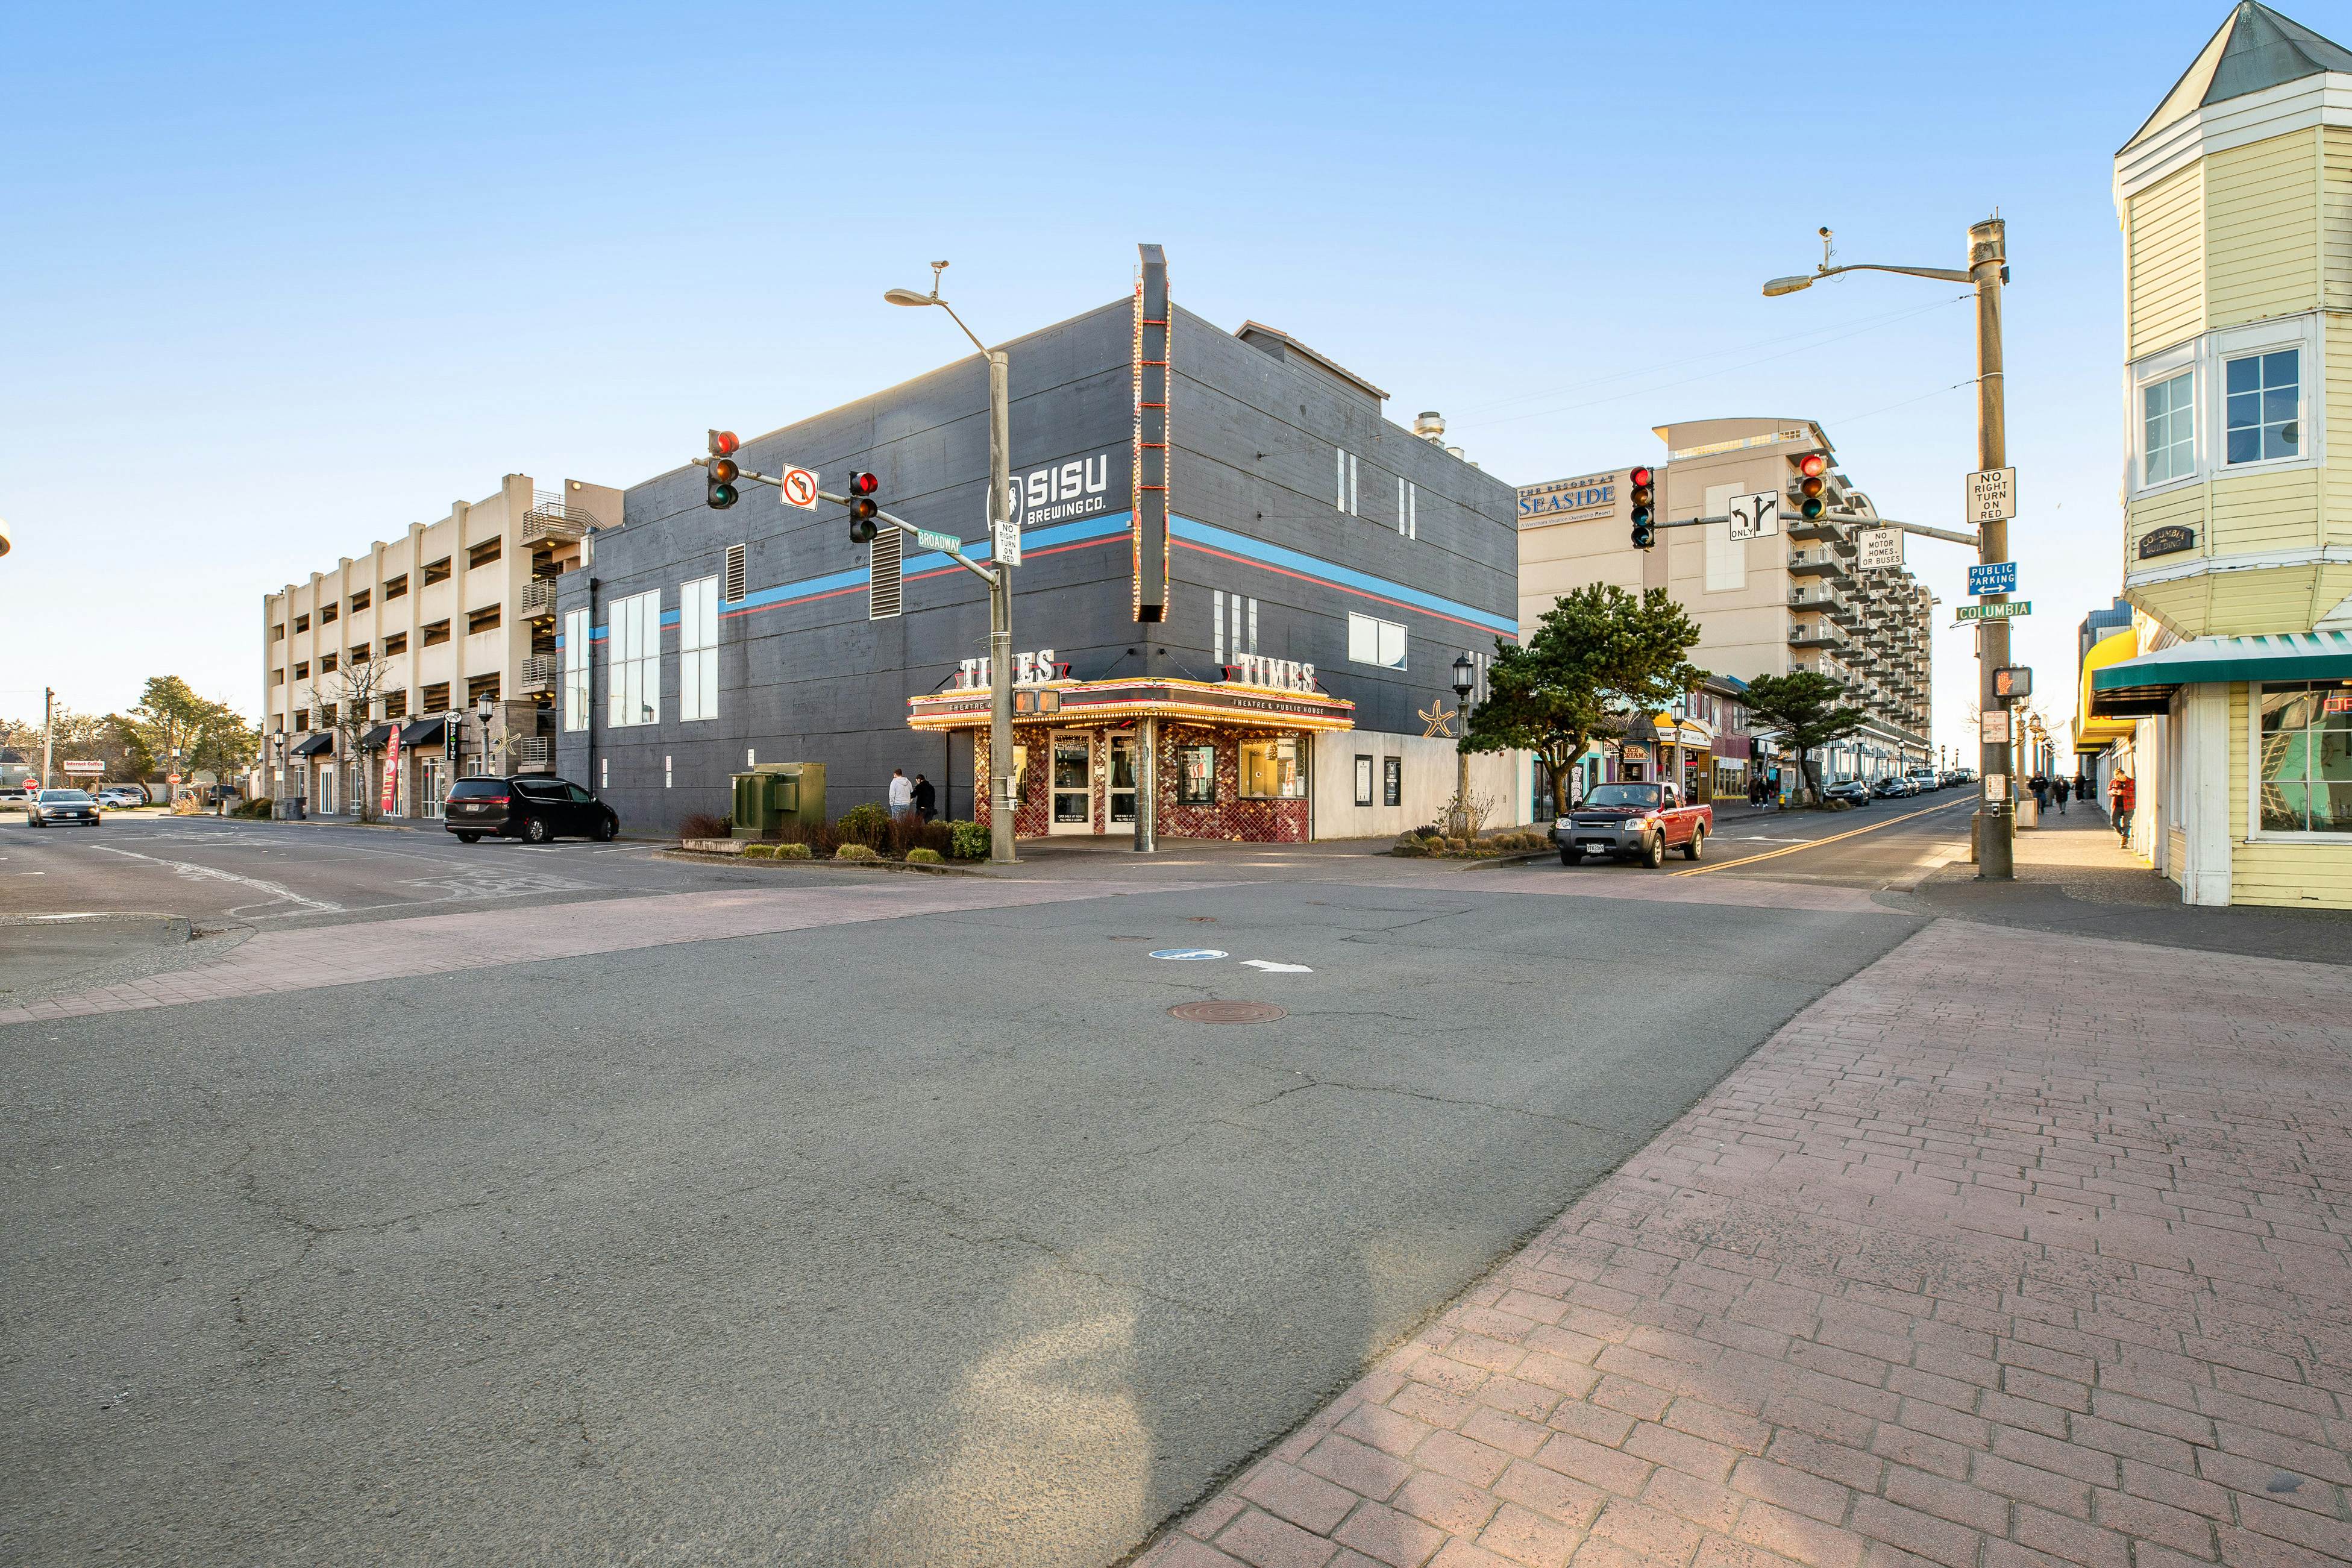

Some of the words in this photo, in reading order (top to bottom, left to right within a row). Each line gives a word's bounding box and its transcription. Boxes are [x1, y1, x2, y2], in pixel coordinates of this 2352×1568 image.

[1027, 454, 1107, 507] SISU
[1981, 472, 2001, 483] NO
[1519, 488, 1541, 497] THE
[1548, 478, 1594, 492] RESORT
[1600, 475, 1614, 483] AT
[1975, 481, 2007, 493] RIGHT
[1519, 485, 1616, 516] SEASIDE
[1977, 491, 2005, 501] TURN
[1027, 500, 1083, 525] BREWING
[1085, 496, 1106, 512] CO.
[1983, 501, 1999, 509] ON
[1525, 520, 1548, 528] Wyndham
[1569, 512, 1594, 521] Ownership
[1981, 509, 2002, 519] RED
[1002, 523, 1013, 533] NO
[1731, 528, 1754, 538] ONLY
[918, 531, 961, 553] BROADWAY
[999, 532, 1017, 541] RIGHT
[2142, 528, 2185, 547] COLUMBIA
[1001, 539, 1016, 548] TURN
[1869, 539, 1893, 549] MOTOR
[2146, 539, 2181, 553] BUILDING
[1869, 548, 1893, 556] HOMES
[1003, 554, 1014, 563] RED
[1876, 556, 1900, 564] BUSES
[1972, 564, 2013, 577] PUBLIC
[1969, 574, 2015, 586] PARKING
[1960, 603, 2028, 619] COLUMBIA
[960, 649, 1054, 689] TIES
[1238, 653, 1314, 693] TIMES
[949, 702, 984, 711] THEATRE
[1233, 699, 1265, 709] THEATRE
[1276, 704, 1300, 712] PUBLIC
